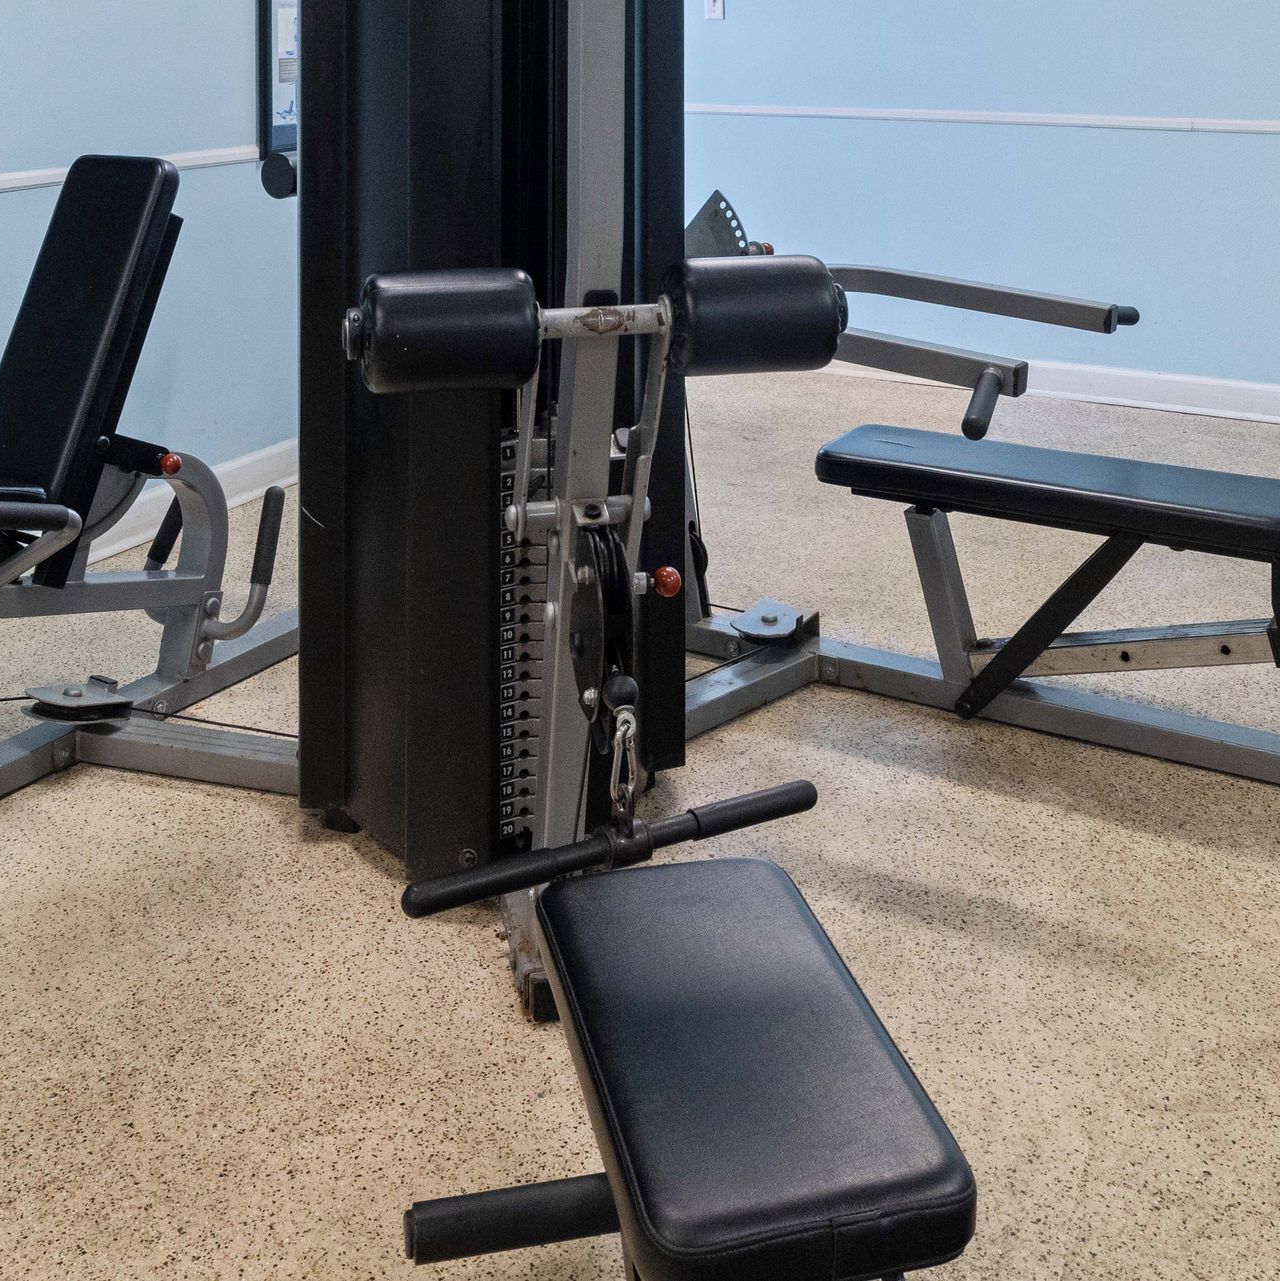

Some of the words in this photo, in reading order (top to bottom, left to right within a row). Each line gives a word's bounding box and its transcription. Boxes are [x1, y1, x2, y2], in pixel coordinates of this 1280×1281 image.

[506, 448, 510, 456] 1
[506, 478, 512, 486] 2
[505, 496, 511, 504] 3
[506, 535, 512, 543] 5
[505, 555, 510, 563] 6
[505, 574, 510, 582] 7
[505, 592, 510, 600] 8
[505, 612, 510, 620] 9
[503, 630, 513, 639] 10
[503, 650, 512, 659] 11
[502, 669, 512, 678] 12
[503, 689, 513, 697] 13
[502, 708, 512, 717] 14
[502, 727, 512, 736] 15
[502, 747, 512, 756] 16
[502, 766, 512, 775] 17
[502, 785, 512, 794] 18
[502, 806, 511, 815] 19
[502, 824, 513, 834] 20
